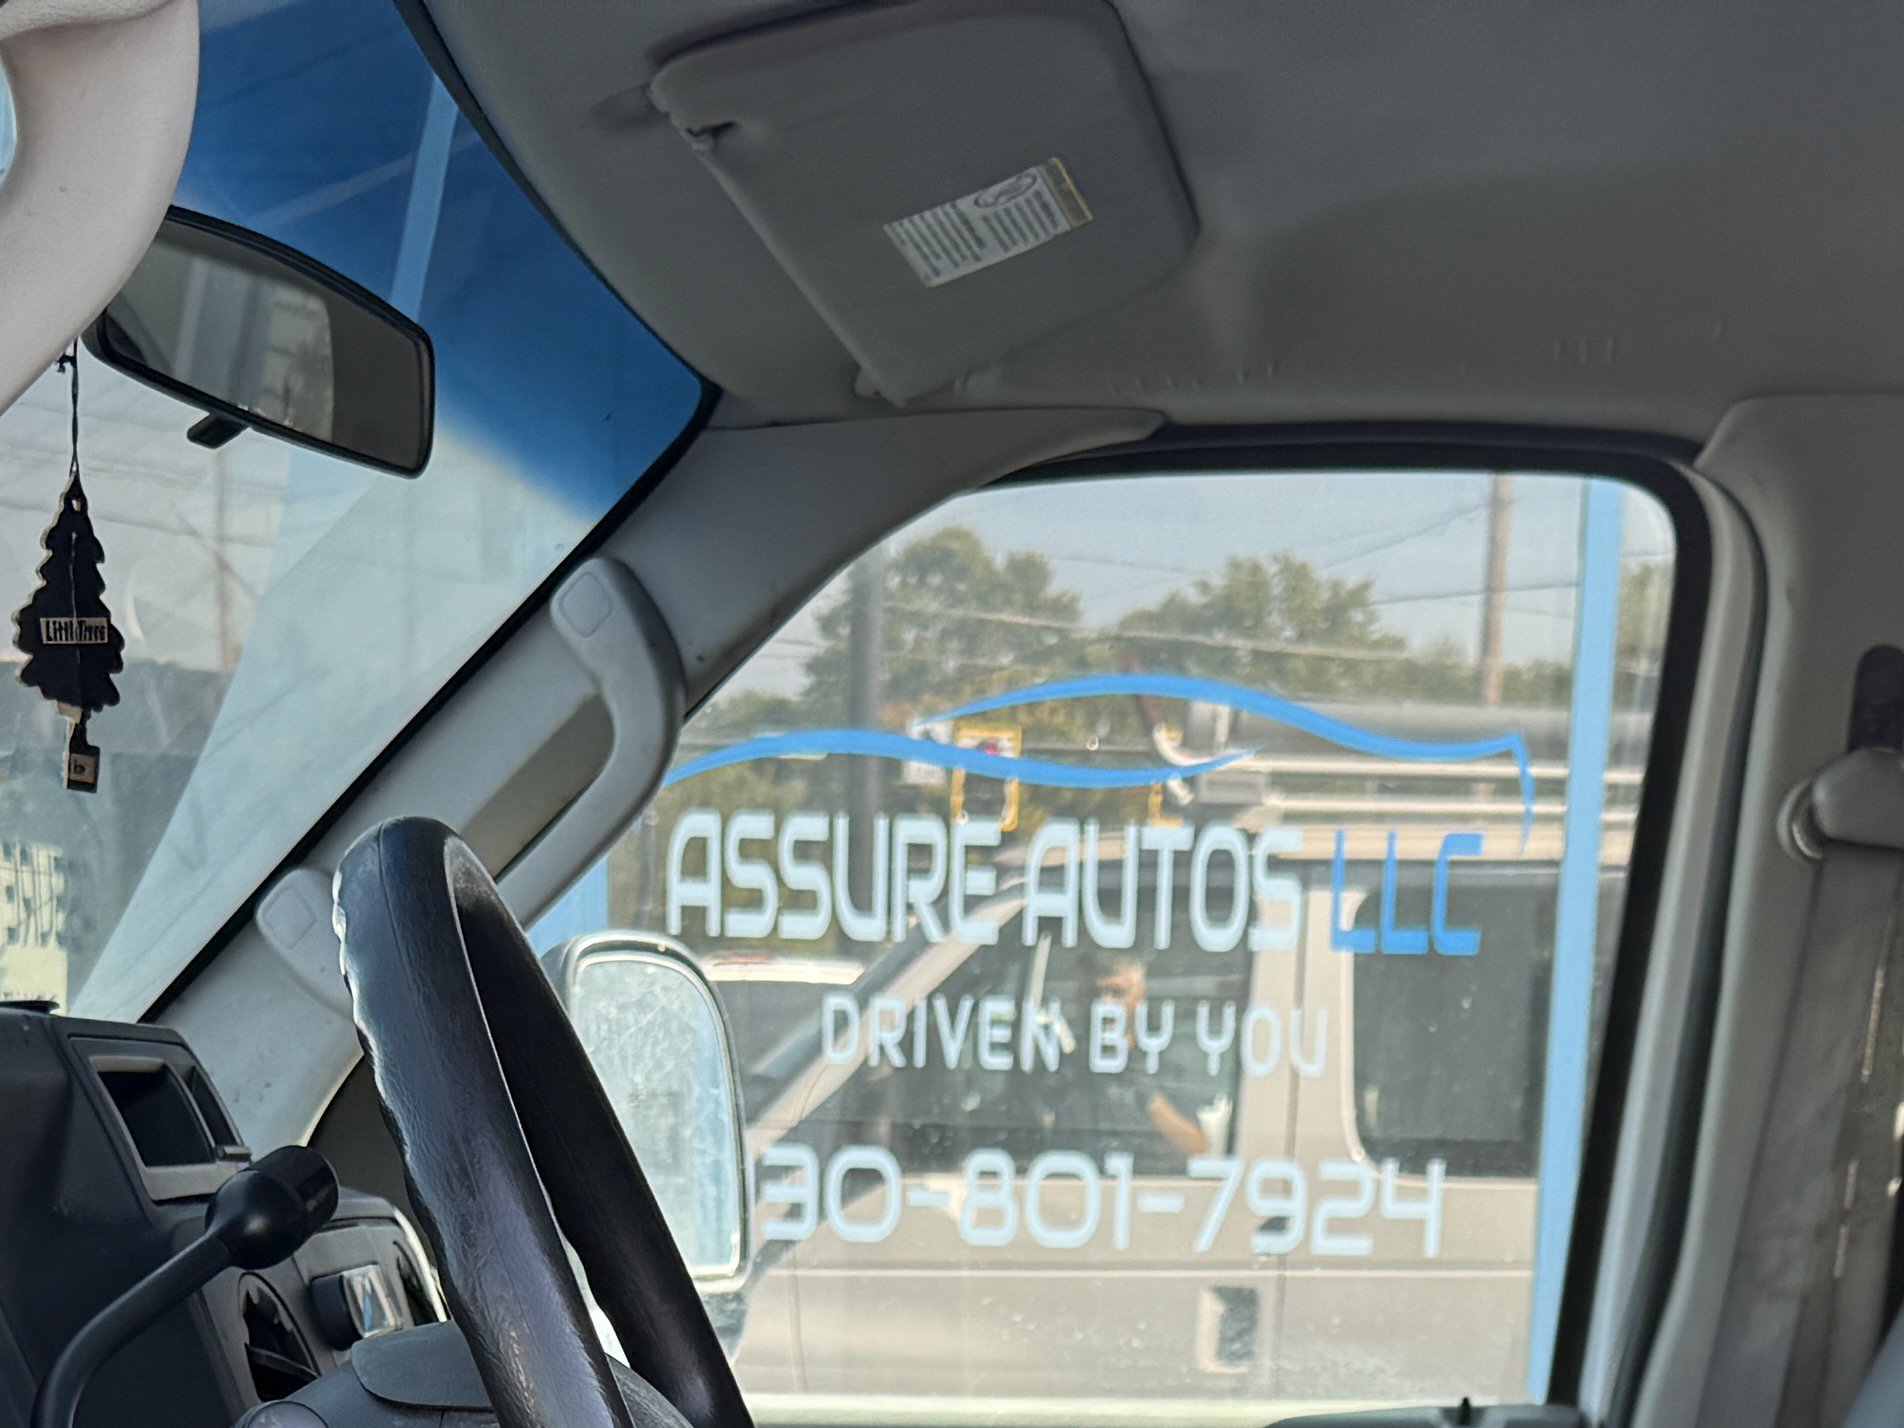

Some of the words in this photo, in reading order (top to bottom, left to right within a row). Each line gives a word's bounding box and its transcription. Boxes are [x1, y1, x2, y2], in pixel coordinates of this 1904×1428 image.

[666, 810, 1001, 943] ASSURE
[1023, 822, 1302, 951] AUTOS
[1330, 829, 1484, 955] LLC
[820, 993, 1062, 1073] DRIVEN
[1089, 998, 1172, 1076] BY
[1196, 999, 1328, 1078] YOU
[759, 1143, 1448, 1256] 30-801-7924
